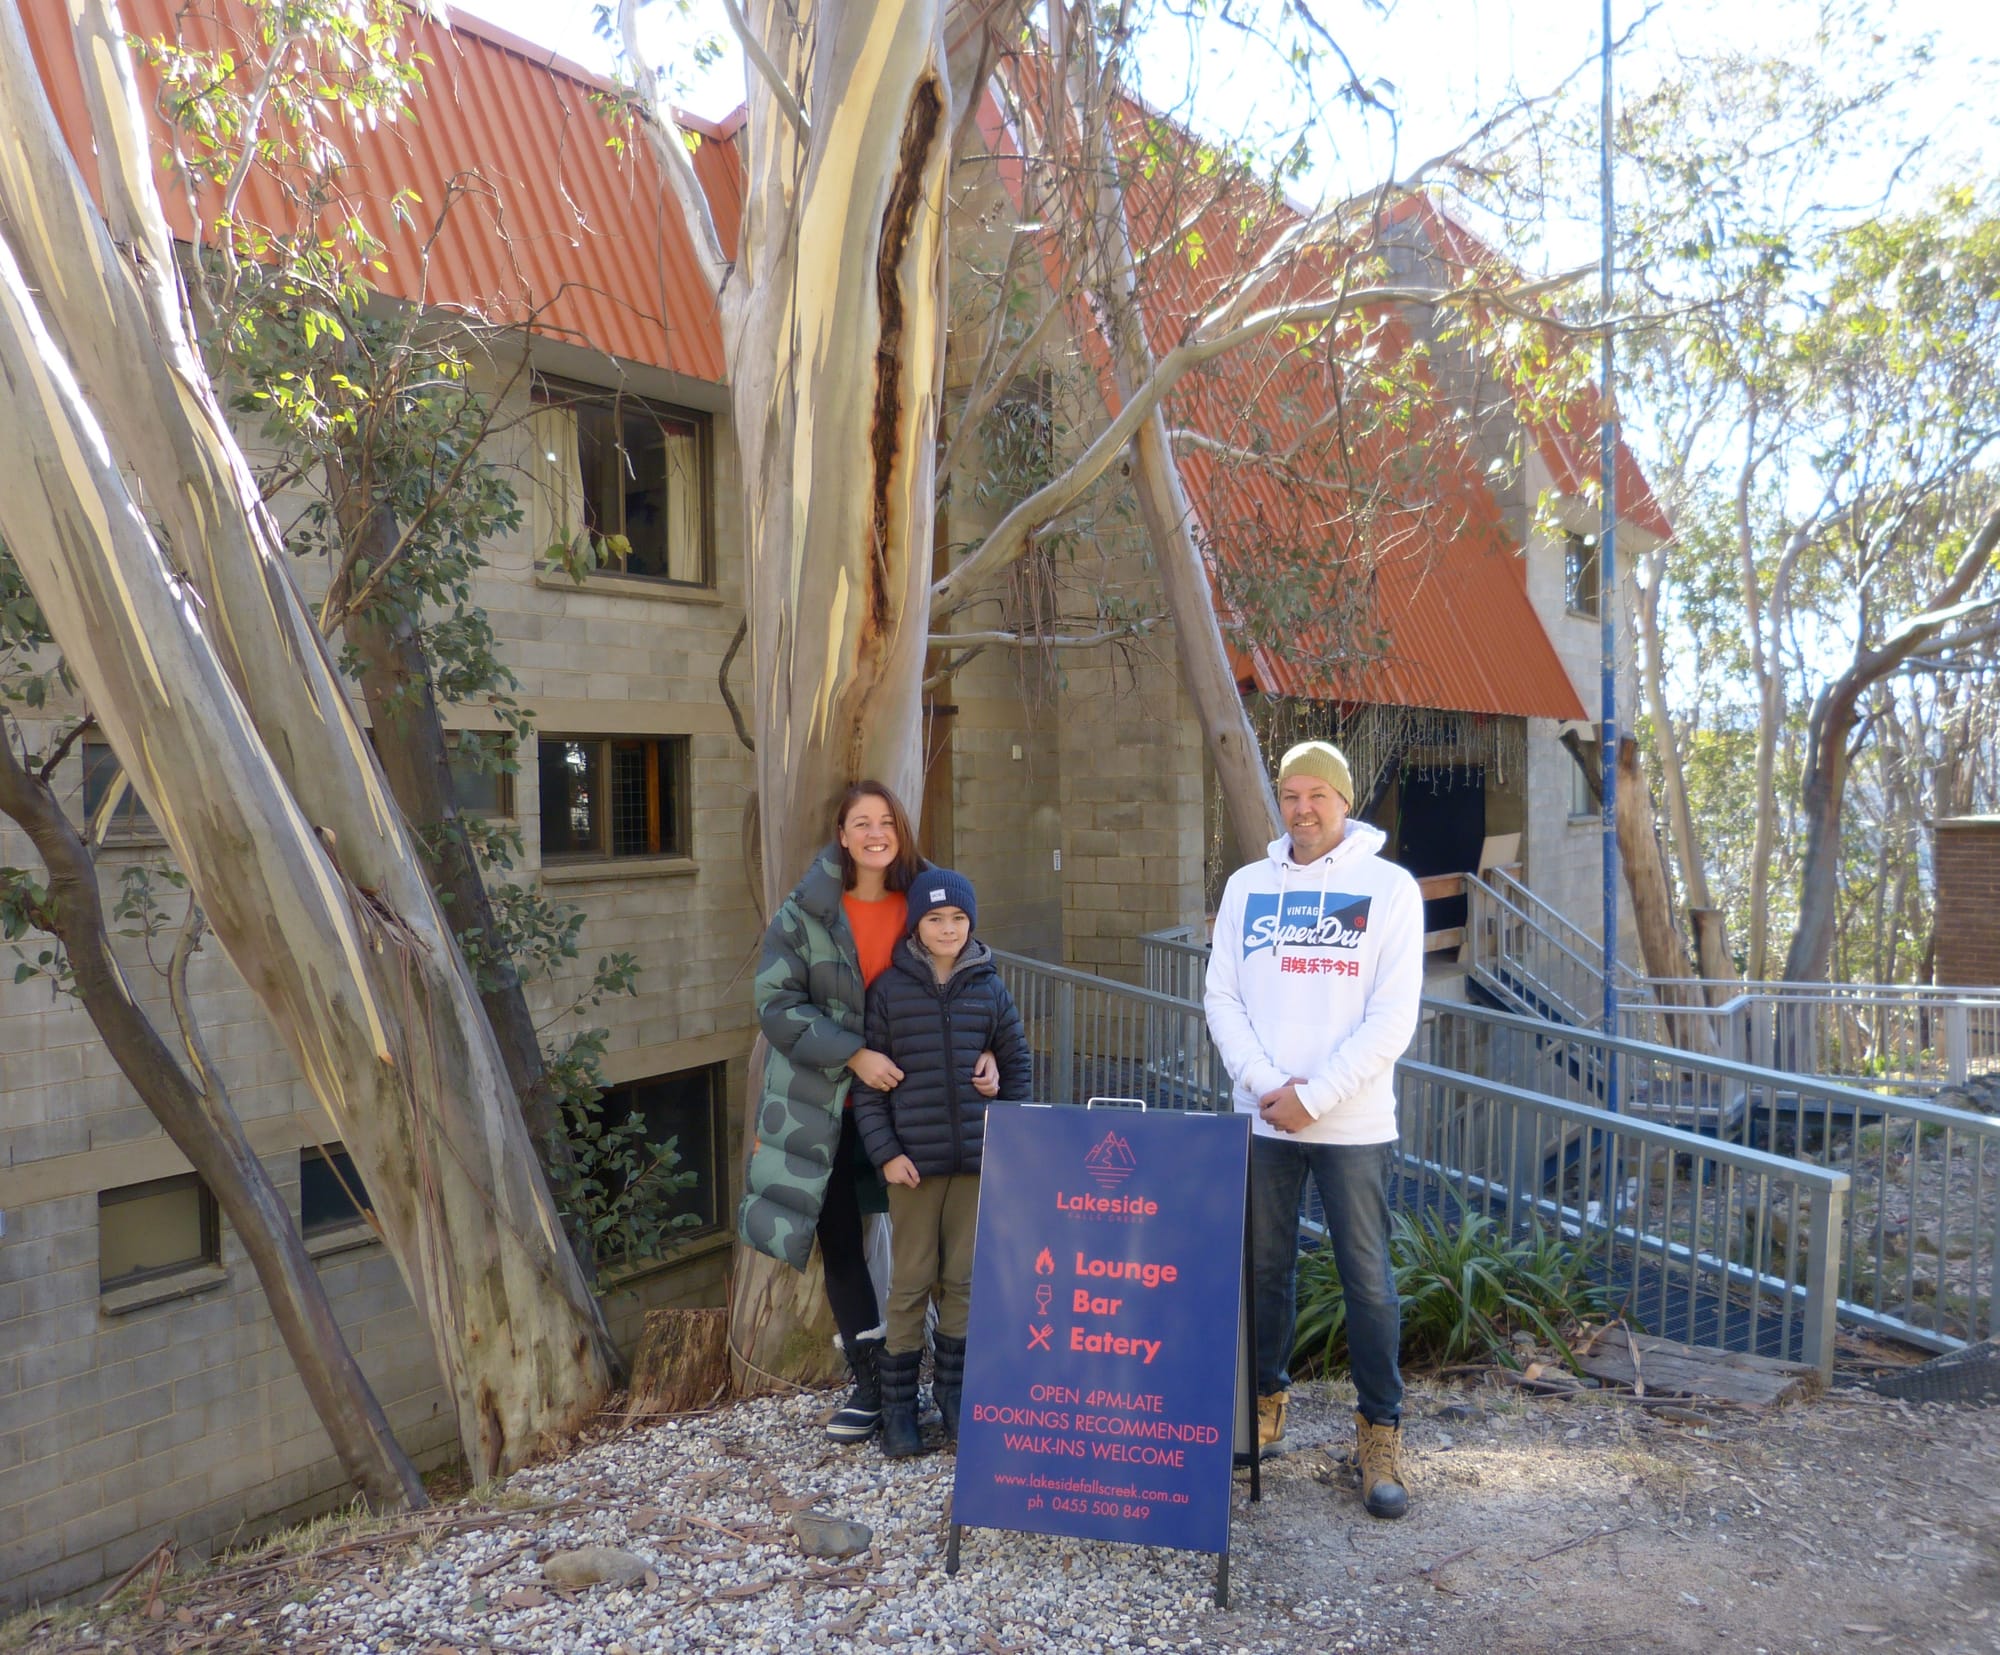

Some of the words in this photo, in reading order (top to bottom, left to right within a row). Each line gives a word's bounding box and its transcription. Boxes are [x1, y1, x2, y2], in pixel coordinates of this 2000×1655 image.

[1056, 1191, 1158, 1216] Lakeside
[1075, 1252, 1177, 1288] Lounge
[1072, 1289, 1122, 1315] Bar
[1070, 1326, 1162, 1364] Eatery
[1029, 1384, 1080, 1405] OPEN
[1085, 1390, 1163, 1413] 4PM-LATE
[973, 1404, 1070, 1430] BOOKINGS
[1075, 1414, 1219, 1444] RECOMMENDED
[1003, 1433, 1086, 1457] WALK-INS
[1091, 1441, 1185, 1467] WELCOME
[994, 1474, 1189, 1504] www.lakesidefallscreek.com.au
[1027, 1495, 1044, 1511] ph
[1052, 1497, 1087, 1513] 0455
[1092, 1501, 1119, 1517] 500
[1123, 1504, 1150, 1520] 849
